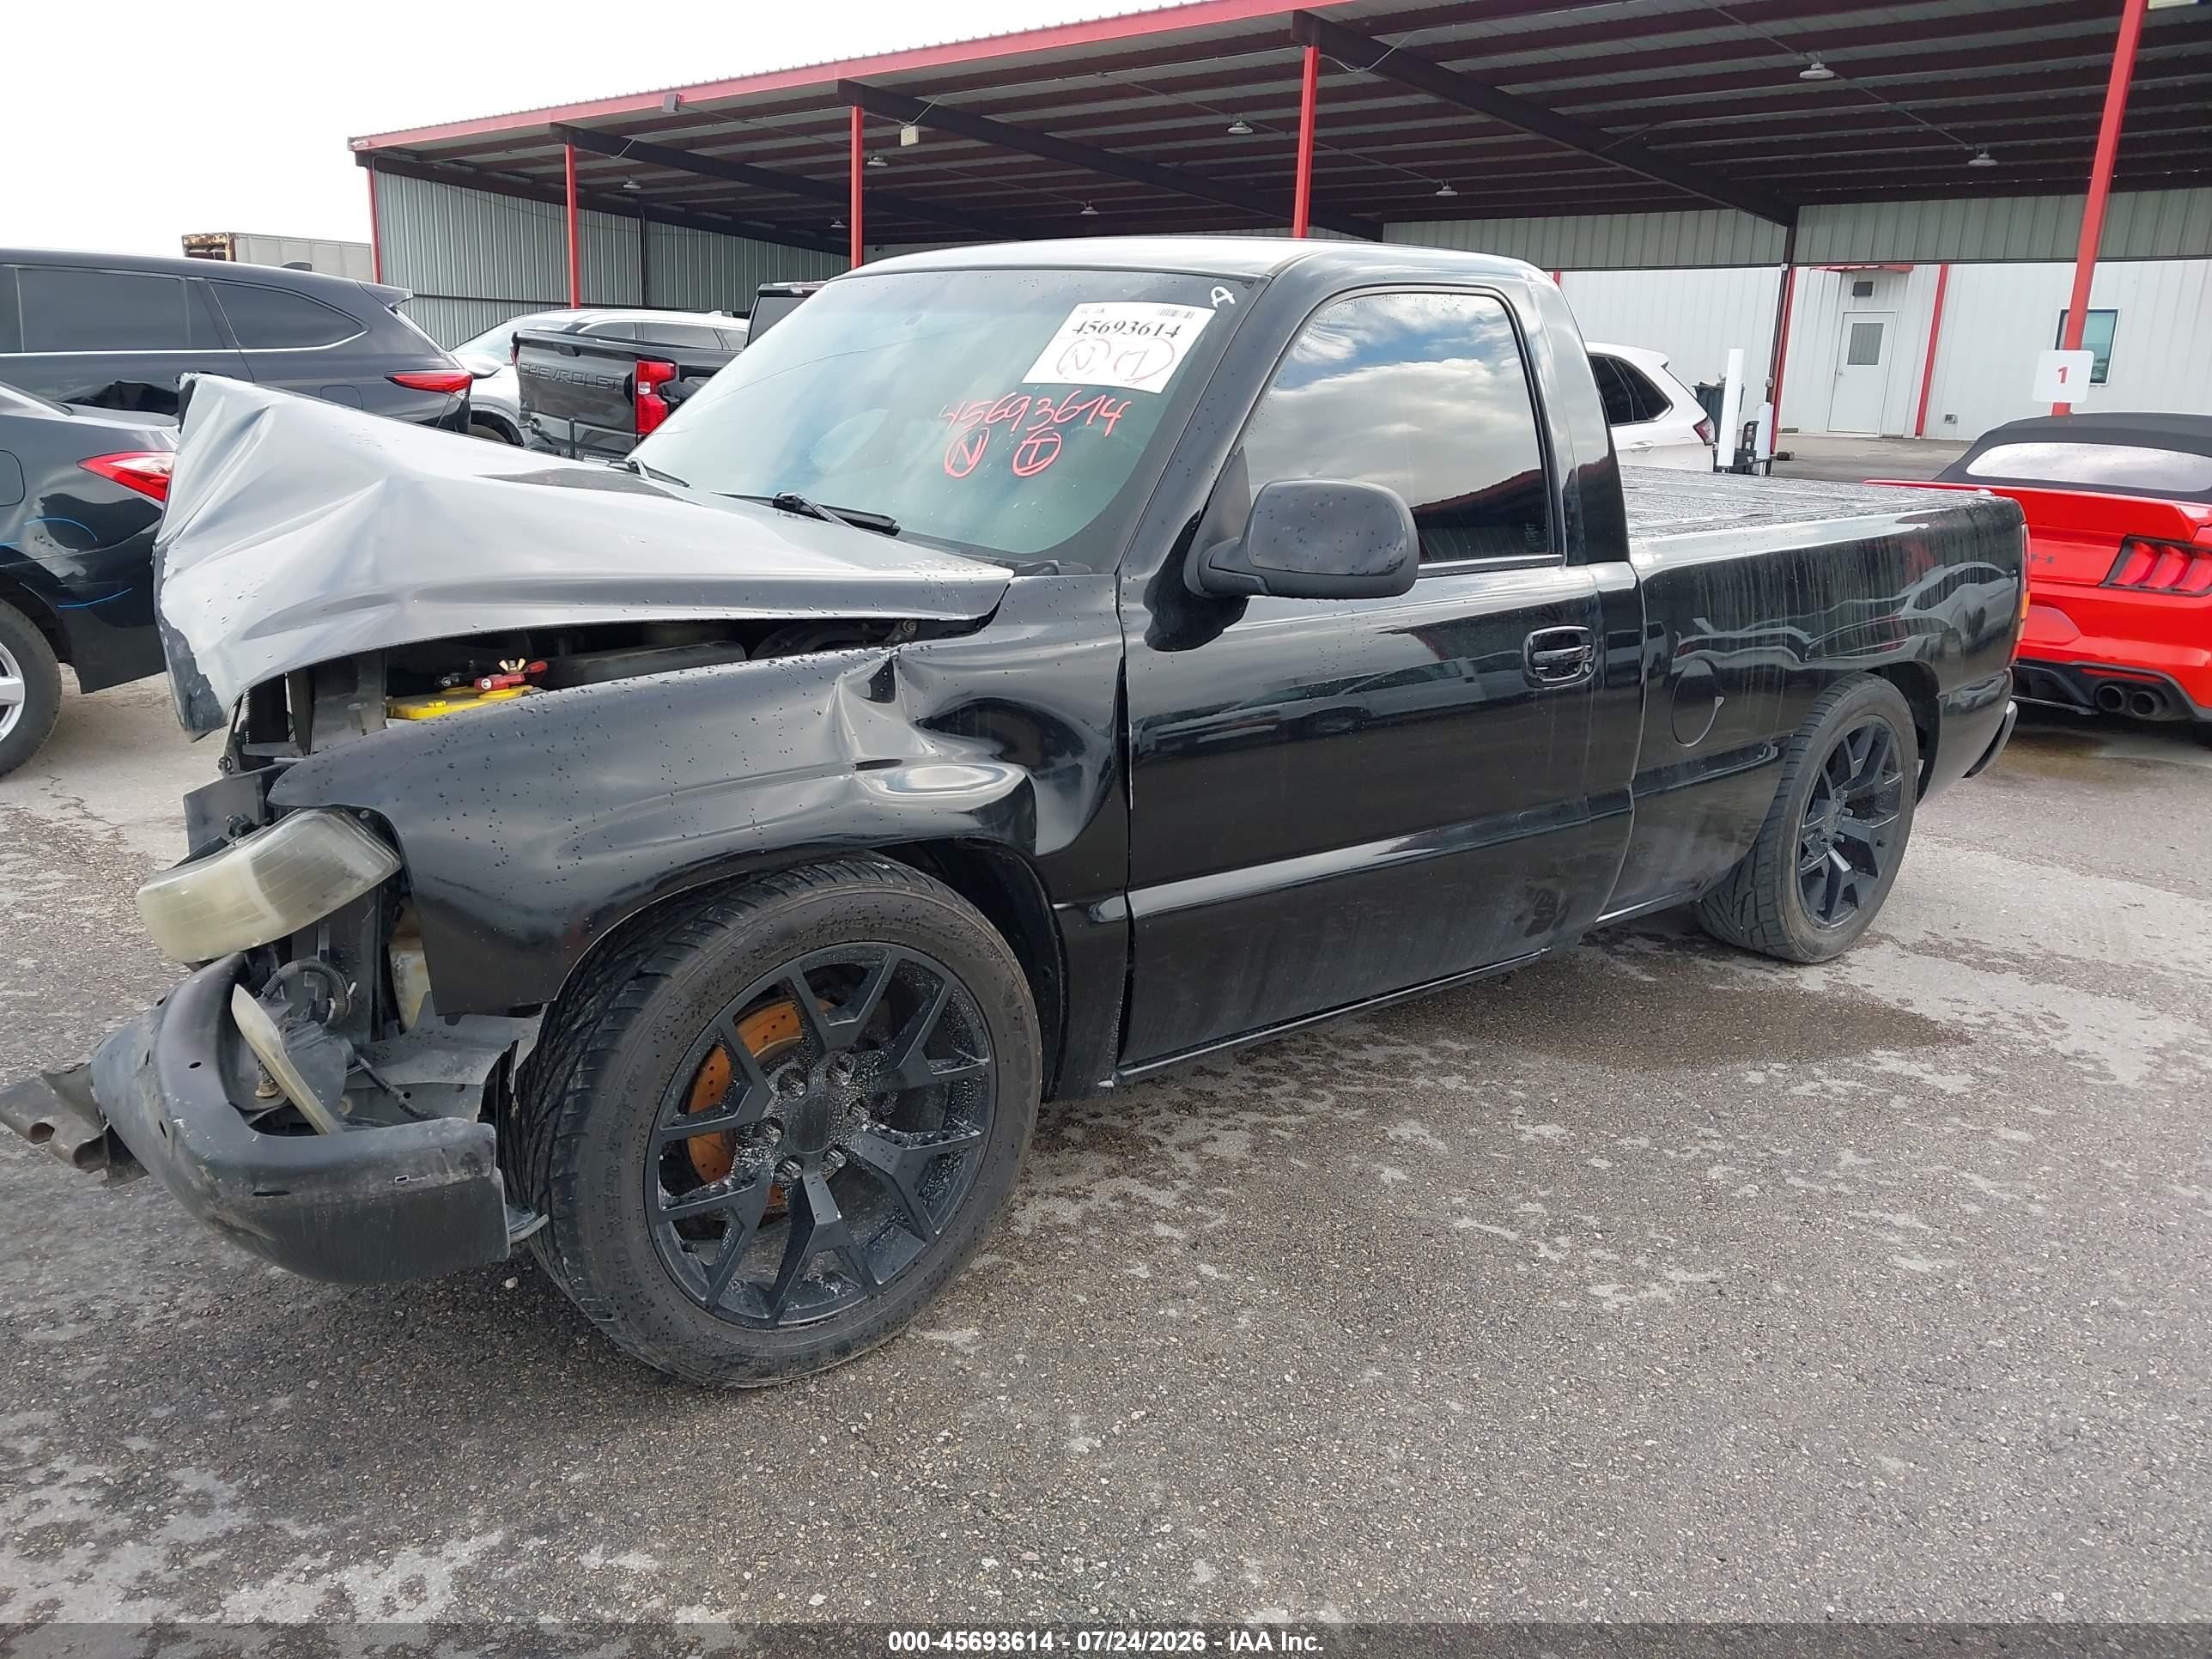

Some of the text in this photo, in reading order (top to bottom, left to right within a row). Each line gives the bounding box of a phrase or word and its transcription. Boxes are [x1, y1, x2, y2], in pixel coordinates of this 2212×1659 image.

[1211, 286, 1237, 307] A
[1073, 320, 1182, 338] 45693614
[520, 362, 623, 391] CHEVROLET
[2057, 366, 2069, 384] 1
[939, 389, 1132, 438] 45693614
